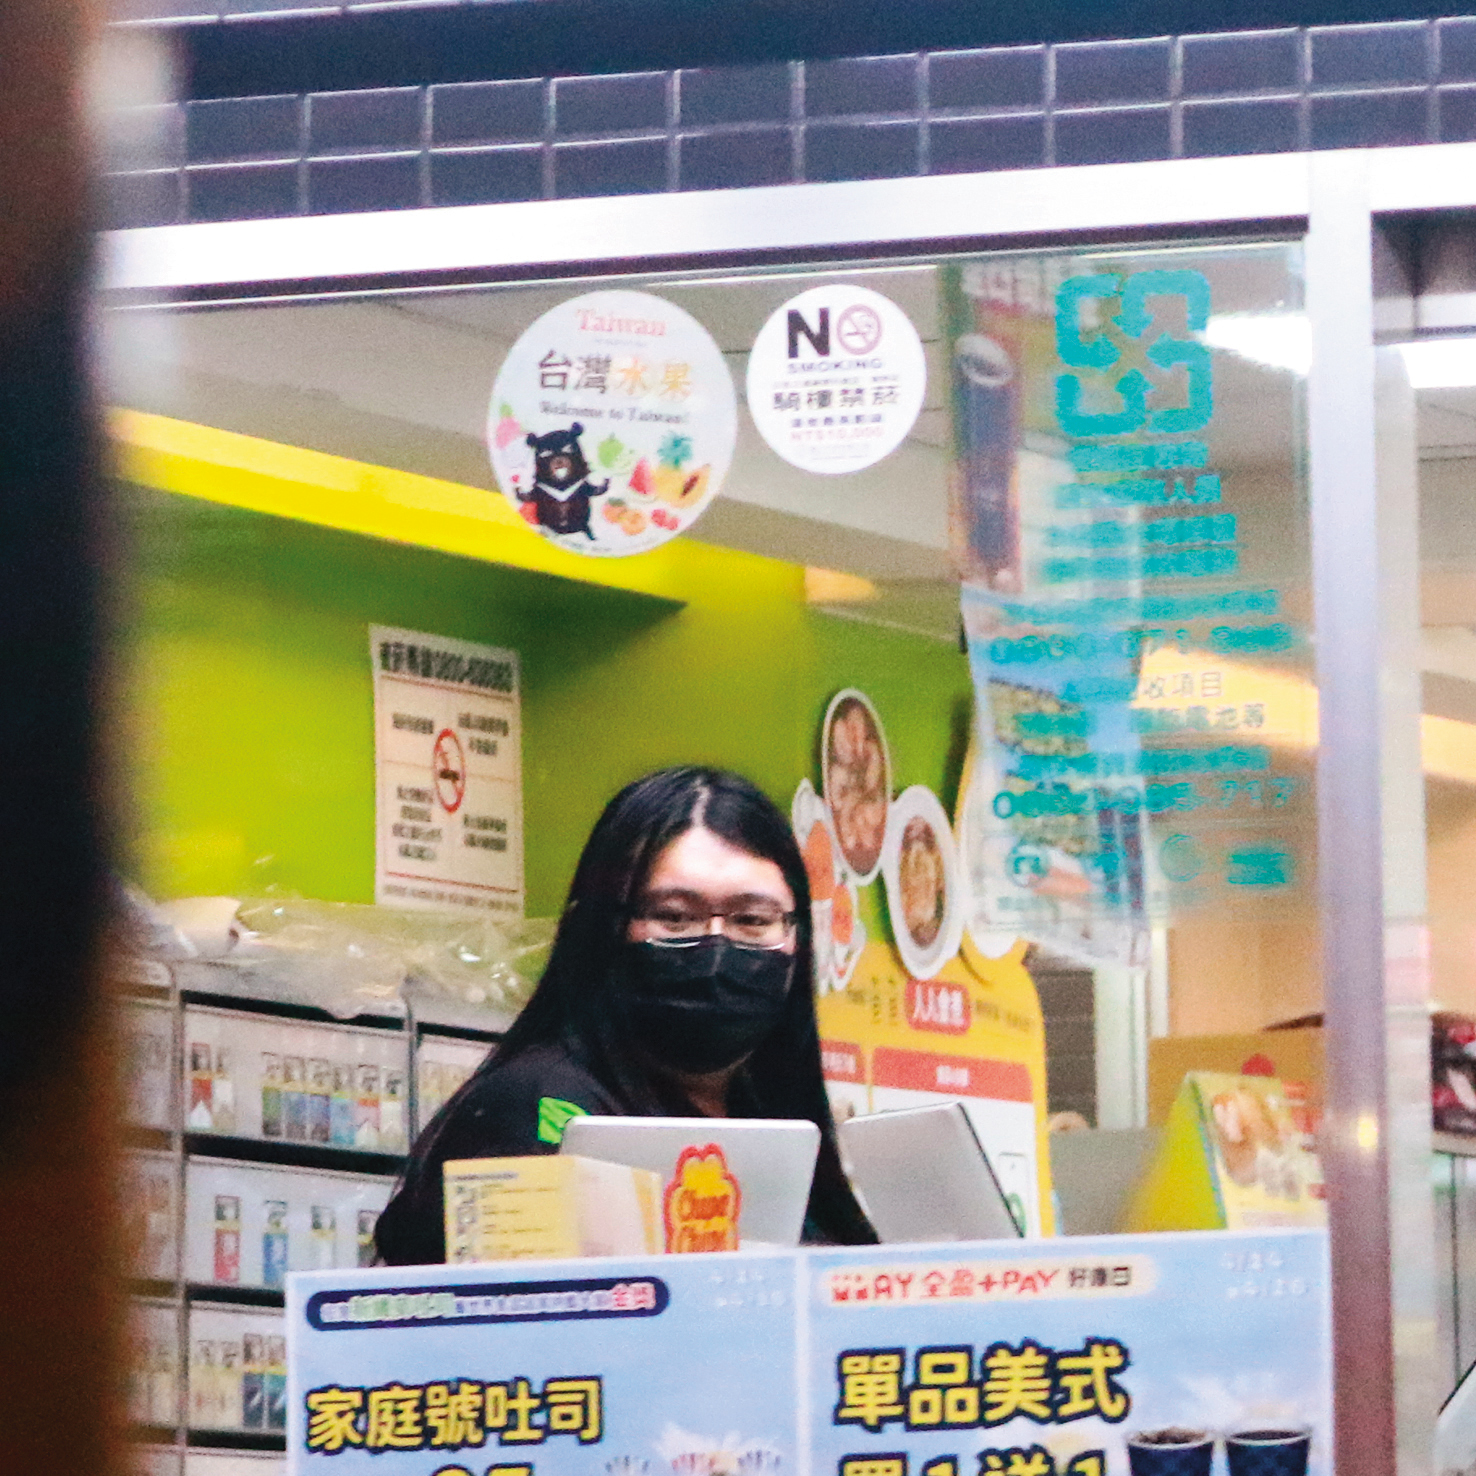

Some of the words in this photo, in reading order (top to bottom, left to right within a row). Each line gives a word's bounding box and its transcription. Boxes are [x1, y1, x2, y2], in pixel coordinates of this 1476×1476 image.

[578, 309, 667, 337] Taiwan
[538, 350, 693, 400] 台灣水果
[305, 1375, 604, 1451] 家庭號吐司
[836, 1340, 1134, 1431] 單品美式
